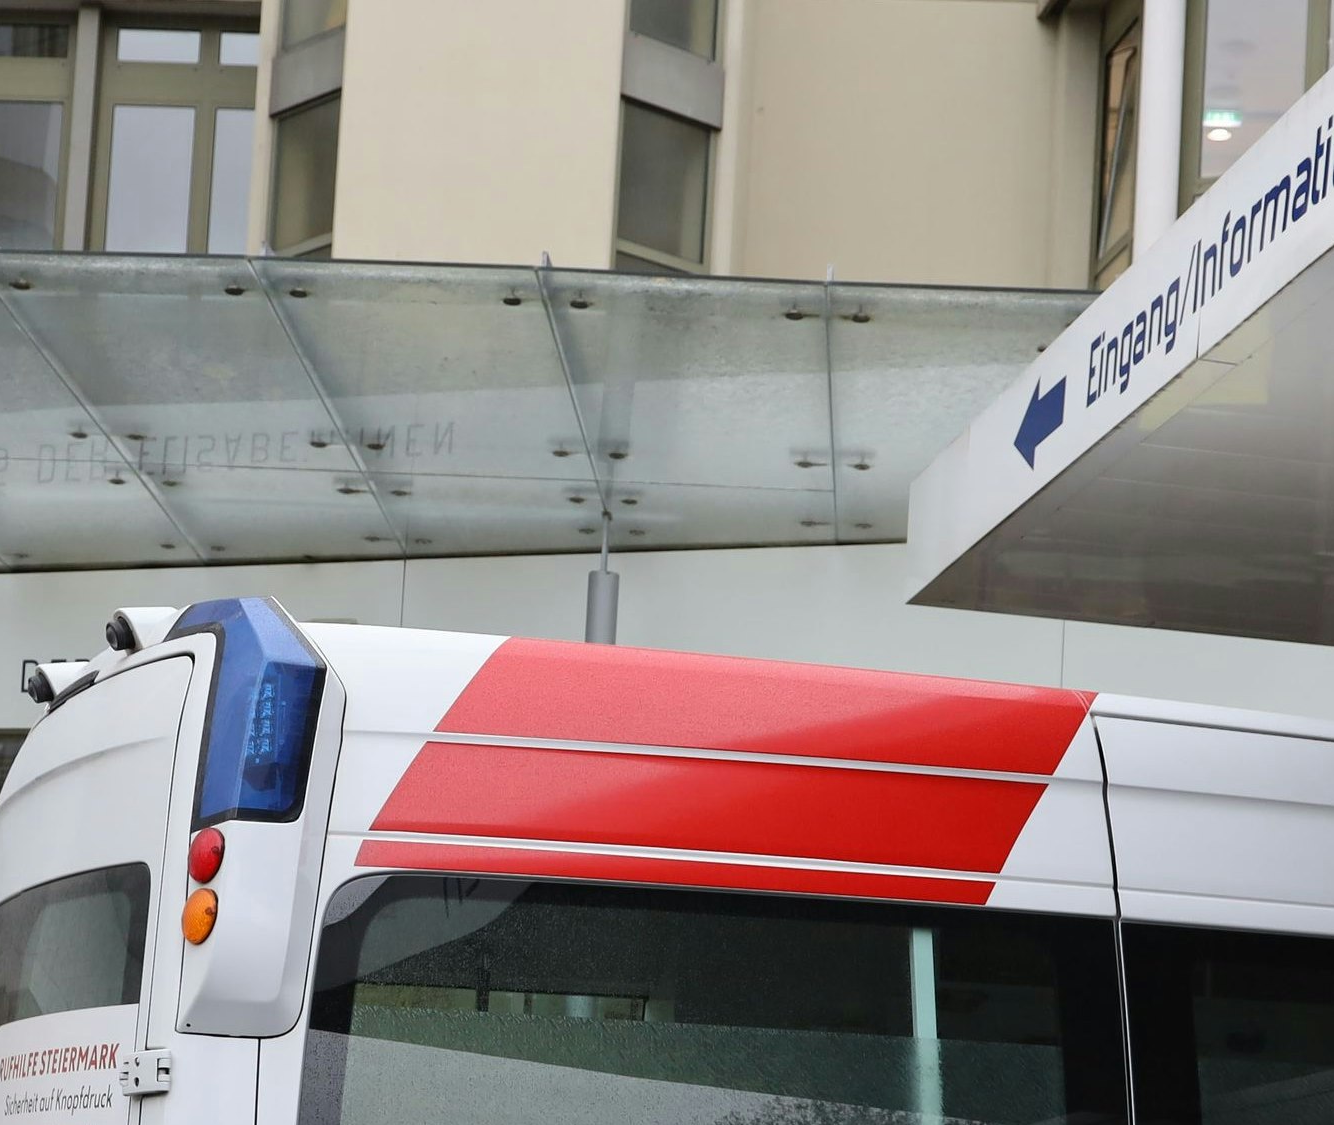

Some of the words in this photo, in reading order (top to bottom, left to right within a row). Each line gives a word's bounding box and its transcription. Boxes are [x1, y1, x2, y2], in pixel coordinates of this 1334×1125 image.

[39, 1043, 120, 1076] STEIERMARK
[4, 1092, 38, 1116] Sicherheit
[40, 1088, 54, 1114] auf
[56, 1084, 113, 1116] Knopfdruck
